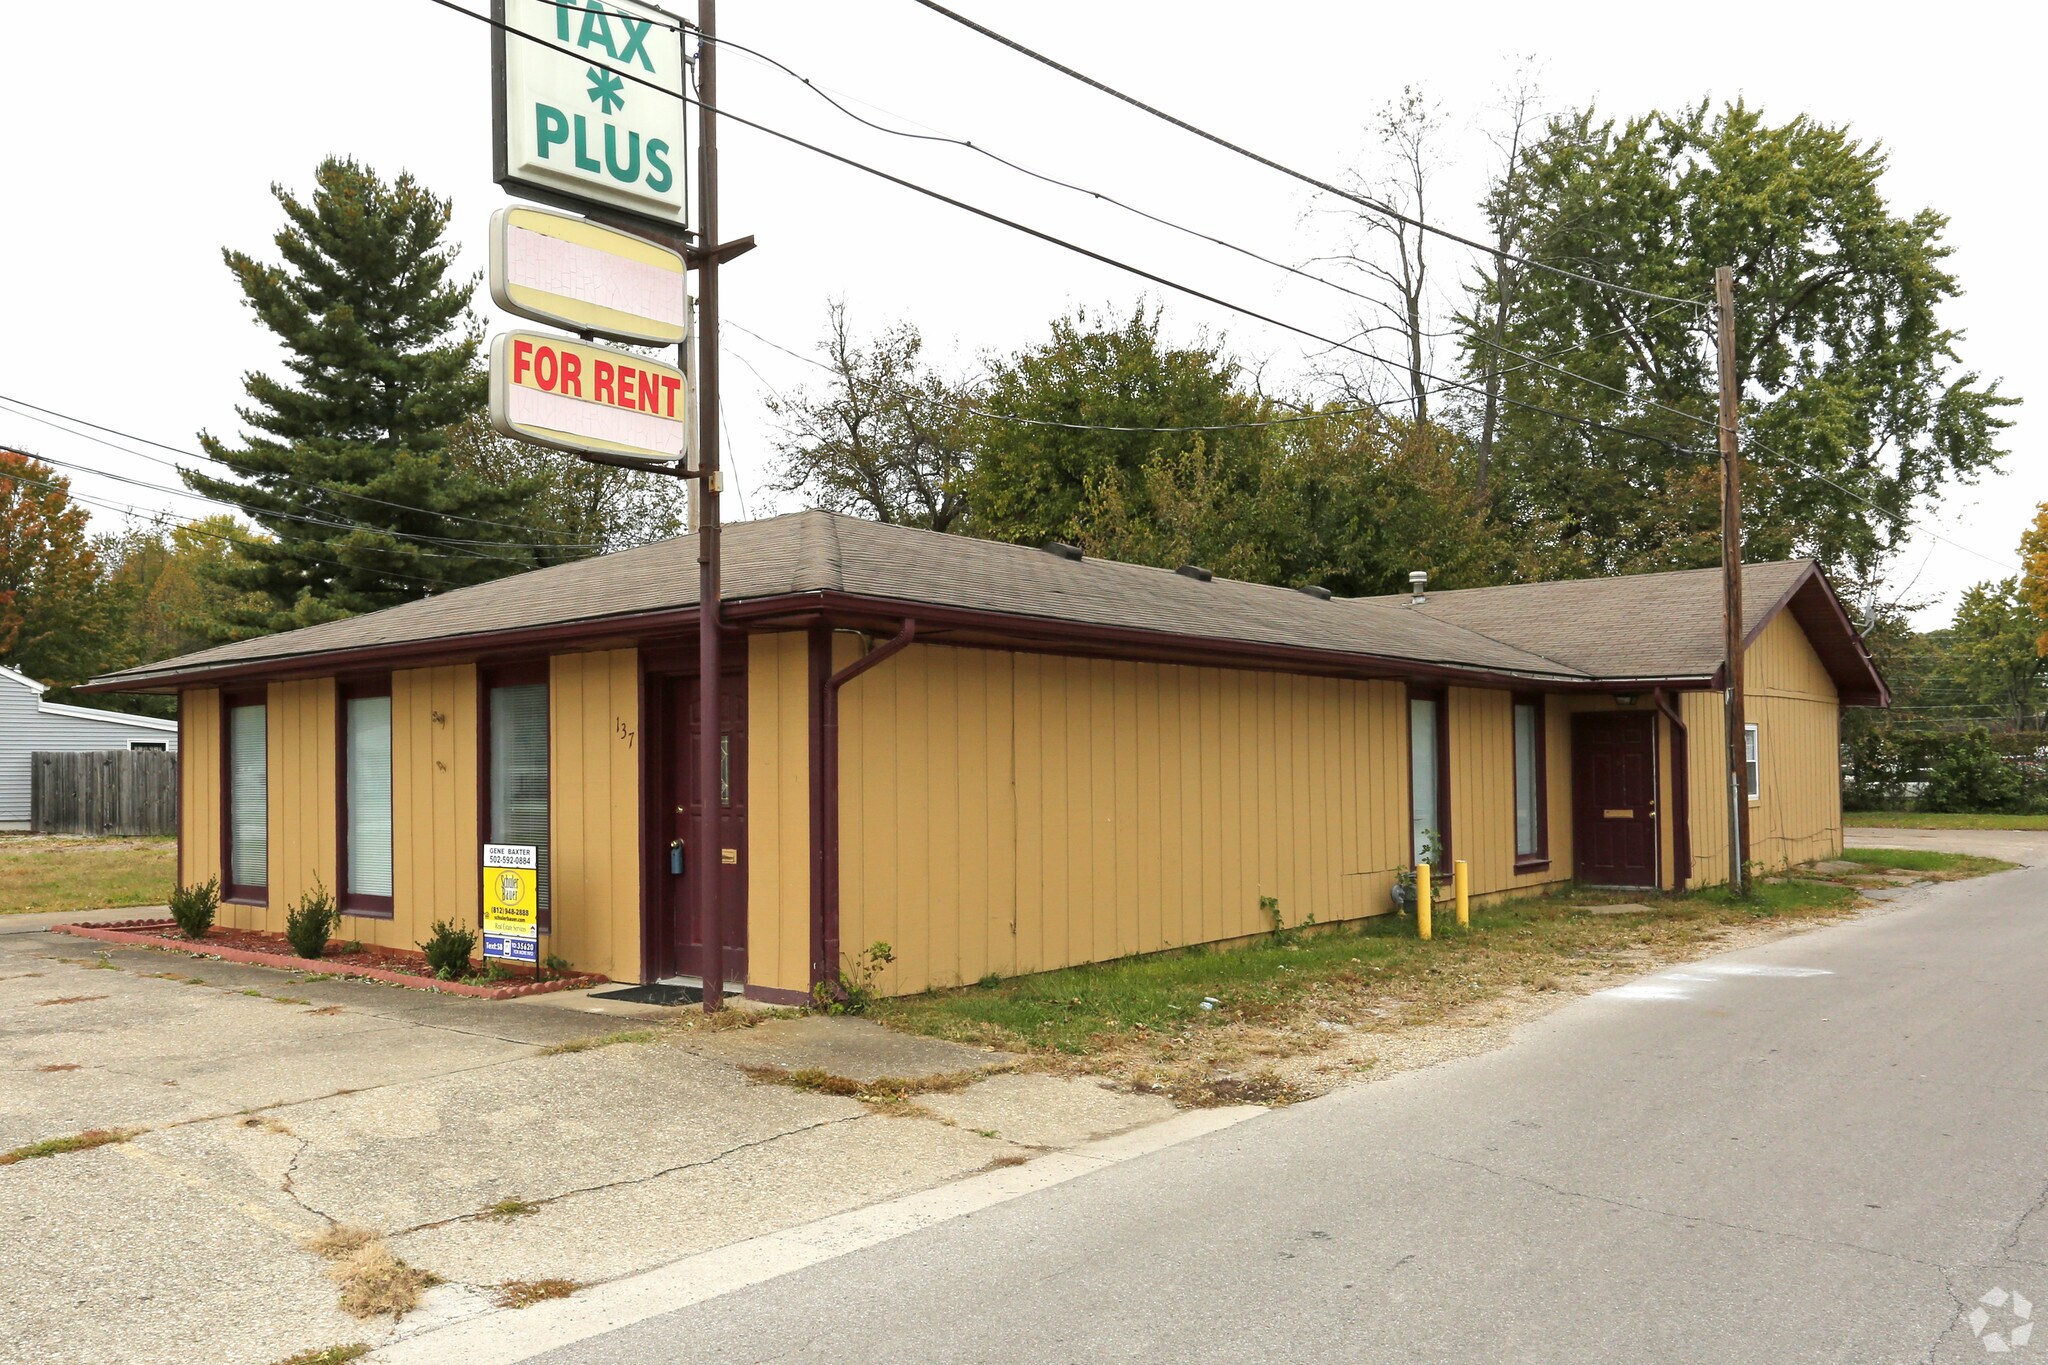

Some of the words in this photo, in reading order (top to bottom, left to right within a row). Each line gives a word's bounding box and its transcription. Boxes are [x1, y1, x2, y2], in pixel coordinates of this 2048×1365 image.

[553, 0, 656, 73] TAX
[536, 102, 673, 193] PLUS
[514, 340, 582, 397] FOR
[595, 360, 680, 417] RENT
[616, 717, 634, 748] 137
[490, 856, 530, 864] 502-592-0884
[505, 908, 529, 916] 948-2888
